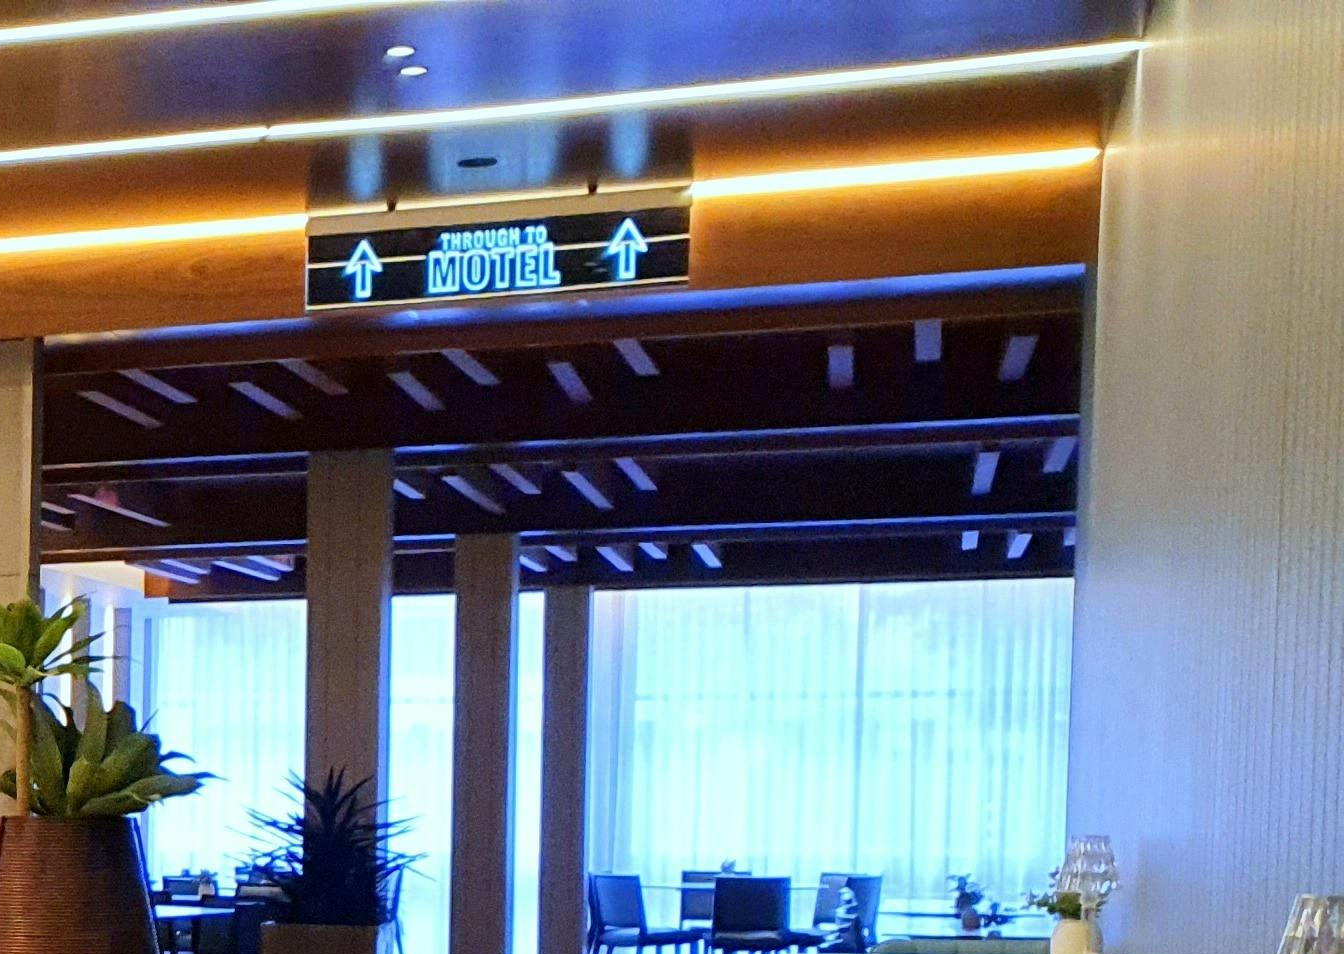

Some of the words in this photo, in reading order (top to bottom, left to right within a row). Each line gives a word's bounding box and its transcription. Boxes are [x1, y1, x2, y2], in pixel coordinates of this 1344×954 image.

[441, 227, 520, 250] THROUGH
[525, 225, 548, 244] TO
[428, 241, 561, 293] MOTEL
